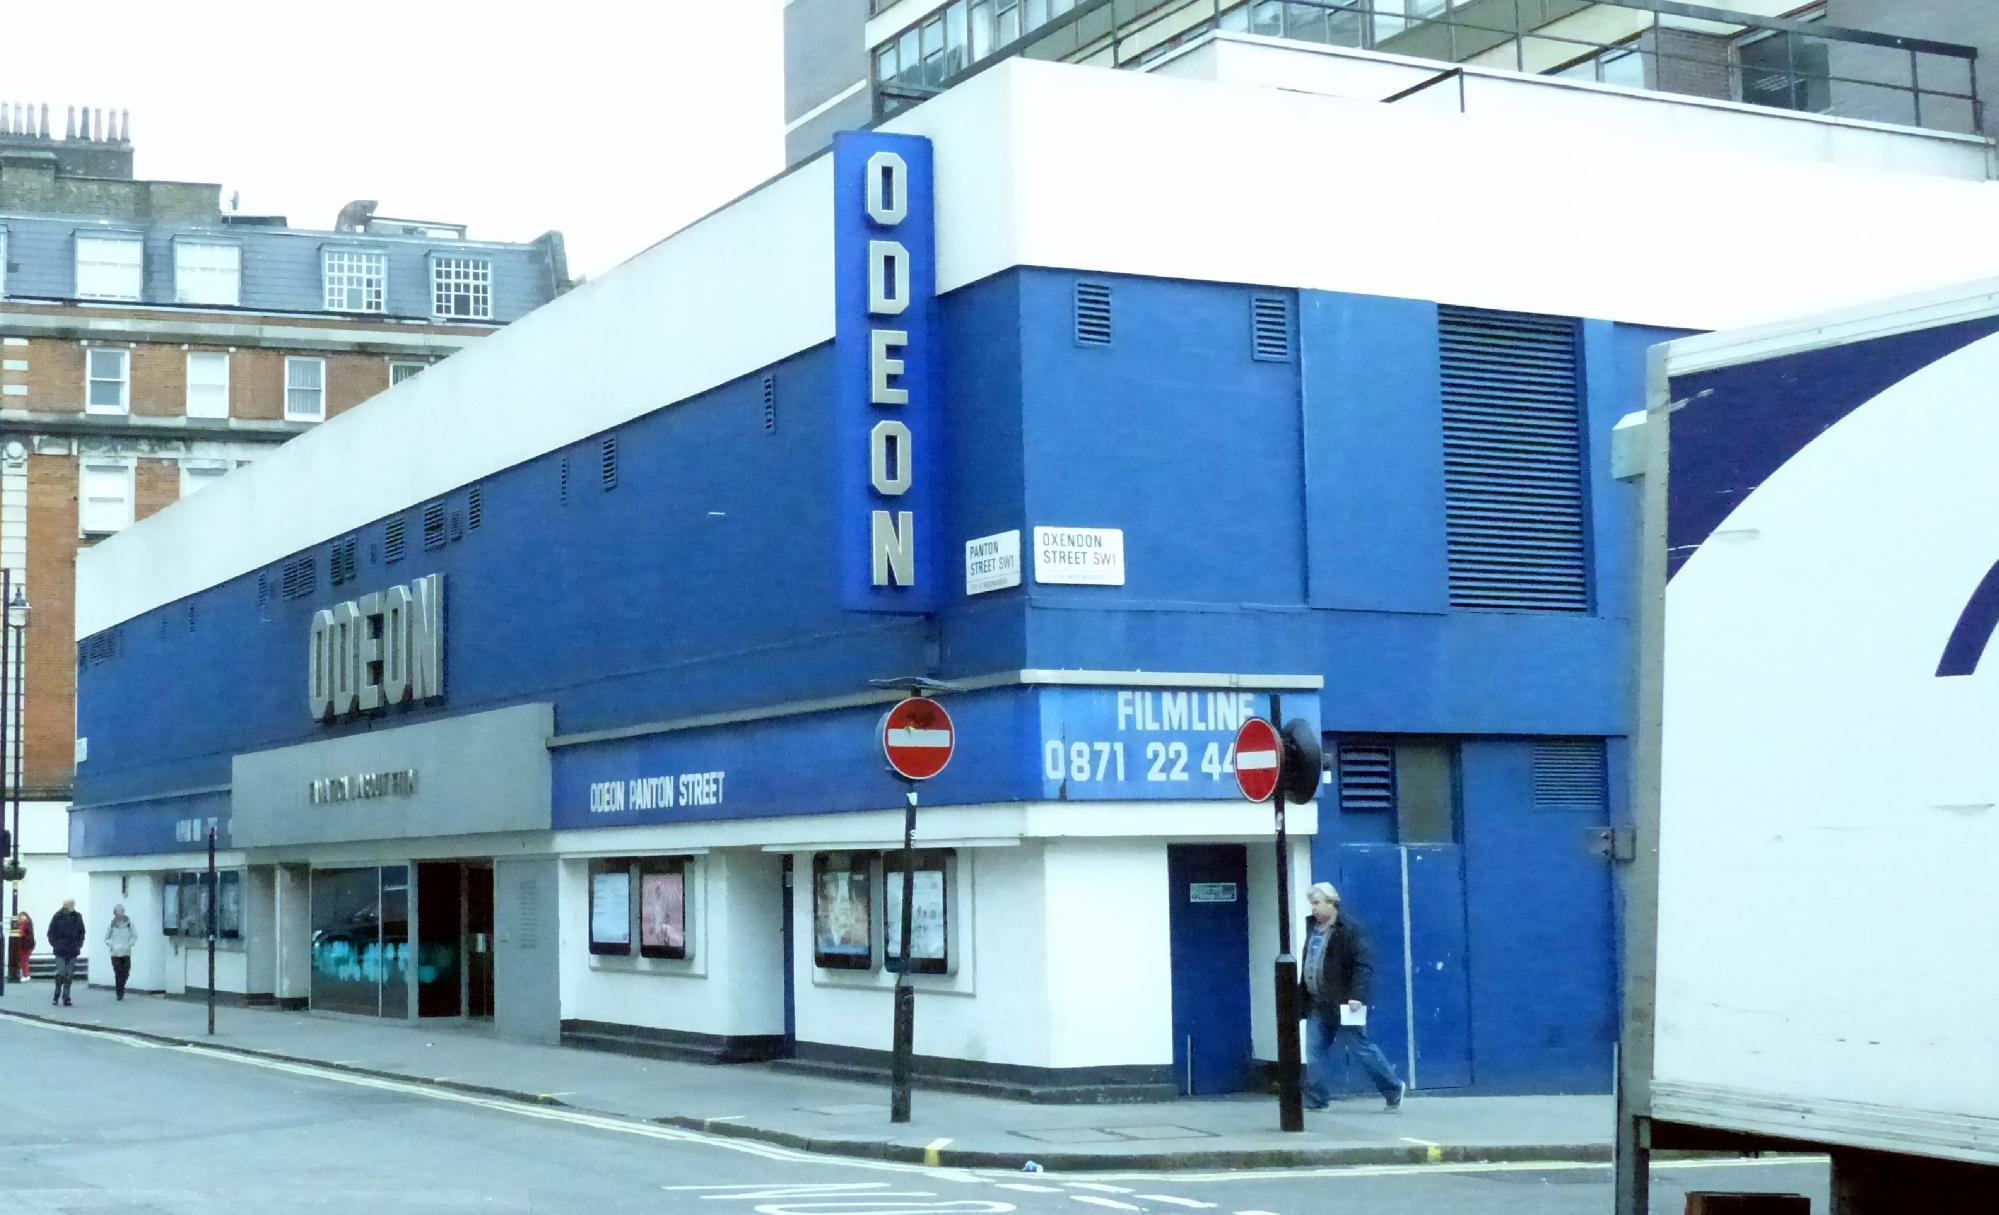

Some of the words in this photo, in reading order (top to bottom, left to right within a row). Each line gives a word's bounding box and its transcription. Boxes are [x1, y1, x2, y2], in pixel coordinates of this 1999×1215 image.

[866, 151, 914, 586] ODEON
[970, 541, 999, 559] PANTON
[1043, 533, 1102, 548] OXENDON
[970, 558, 996, 576] STREET
[998, 557, 1014, 570] SW1
[1043, 550, 1088, 565] STREET
[1093, 552, 1117, 567] SW1
[309, 573, 443, 720] ODEON
[1045, 740, 1125, 782] 0871
[1146, 742, 1189, 782] 22
[590, 781, 625, 812] ODEON
[629, 776, 674, 810] PANTON
[679, 771, 725, 806] STREET
